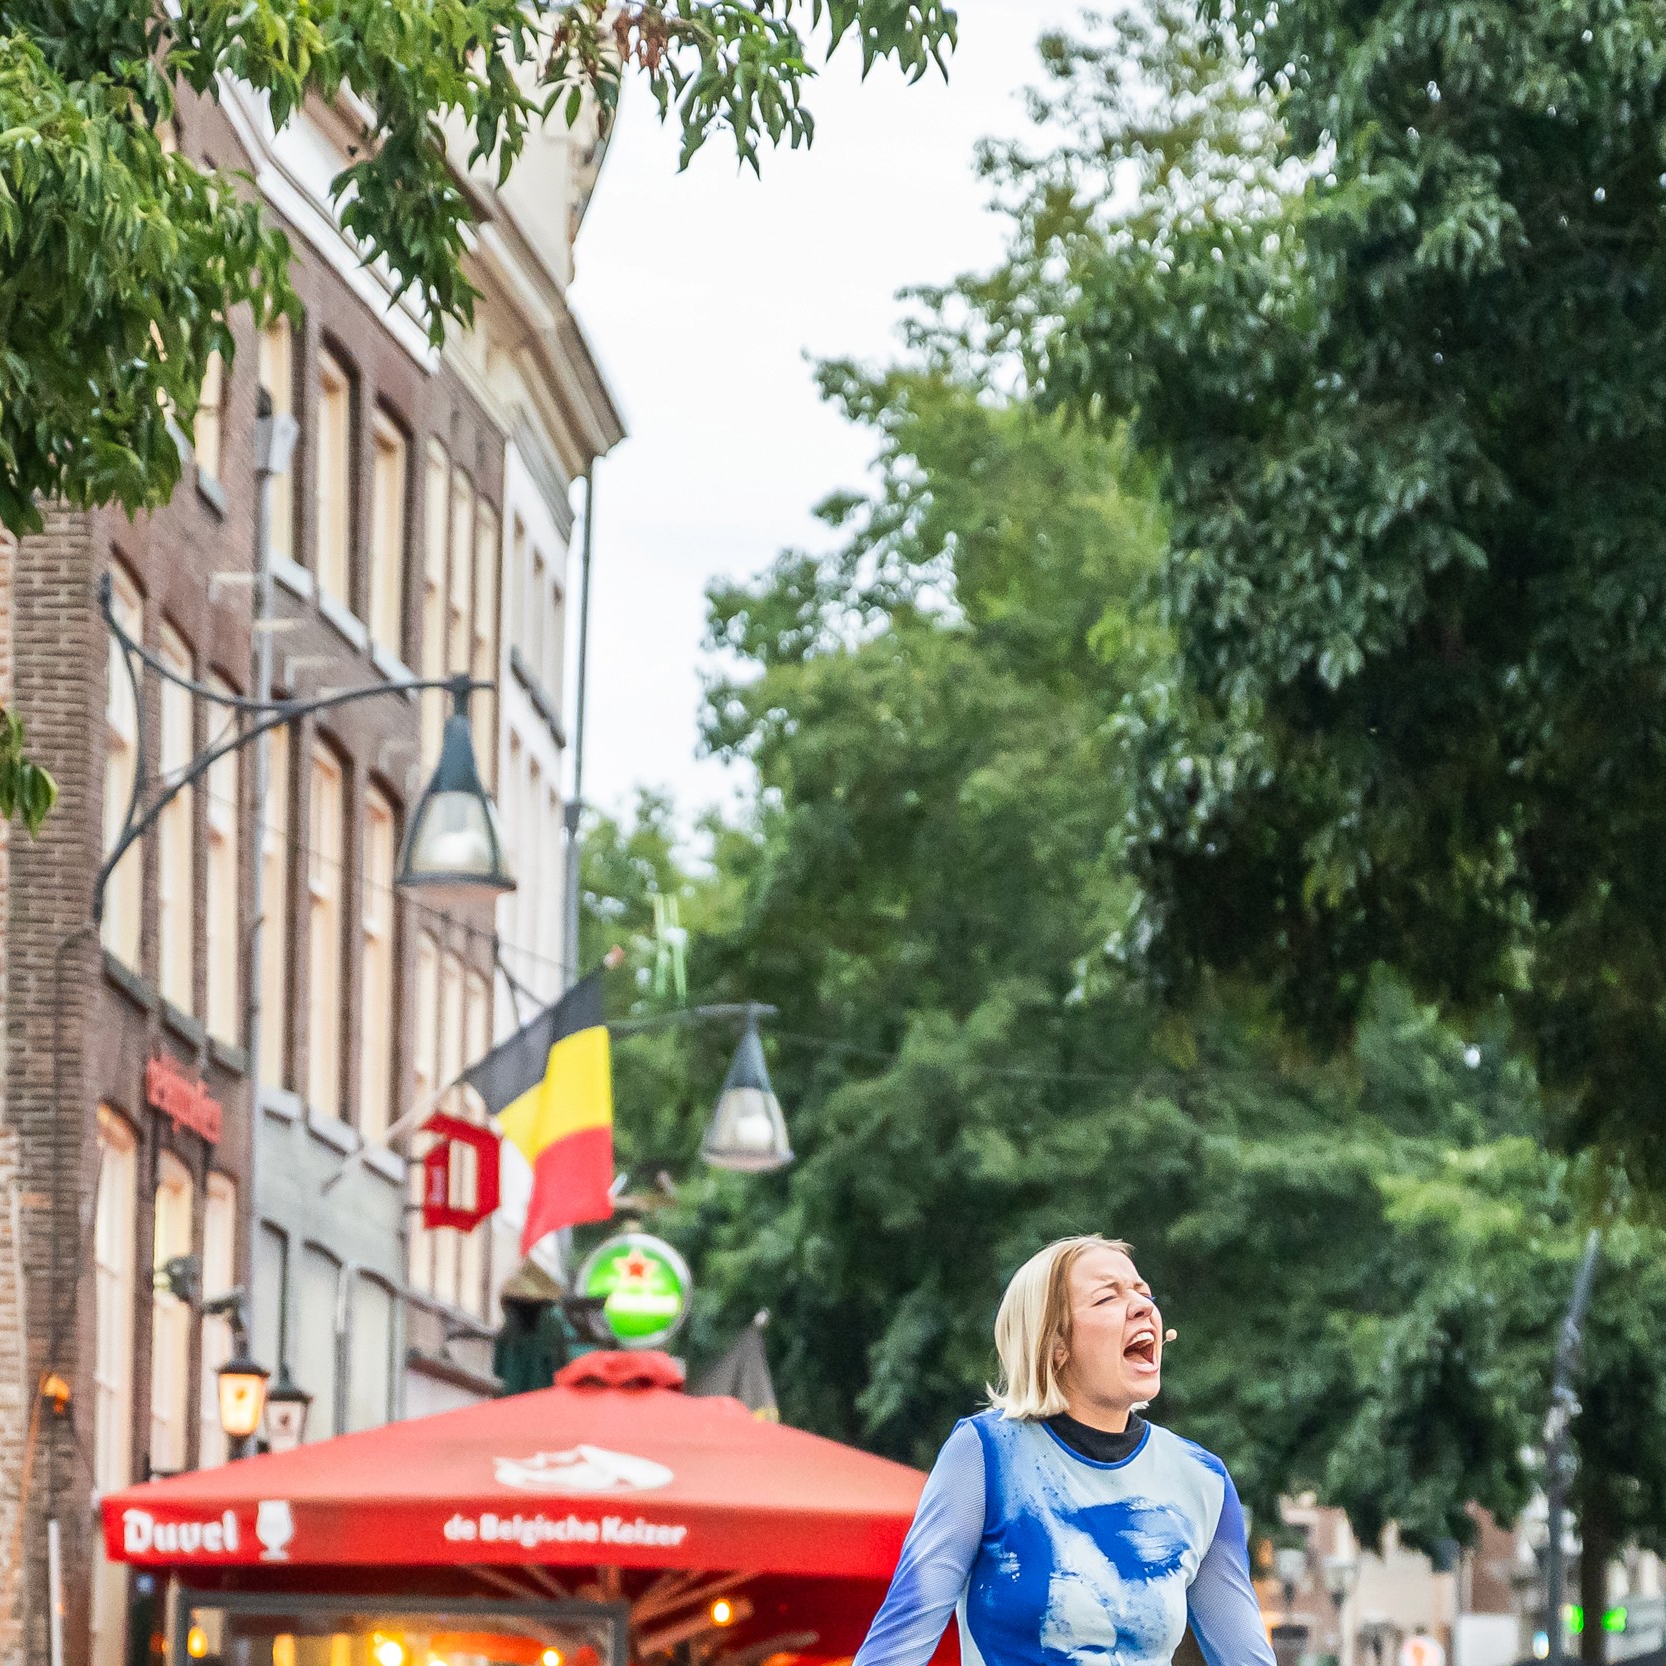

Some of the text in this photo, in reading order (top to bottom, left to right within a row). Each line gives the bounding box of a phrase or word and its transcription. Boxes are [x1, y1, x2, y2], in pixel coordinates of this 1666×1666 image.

[122, 1508, 238, 1554] Duvel
[443, 1513, 477, 1541] de
[479, 1513, 600, 1548] Belgische
